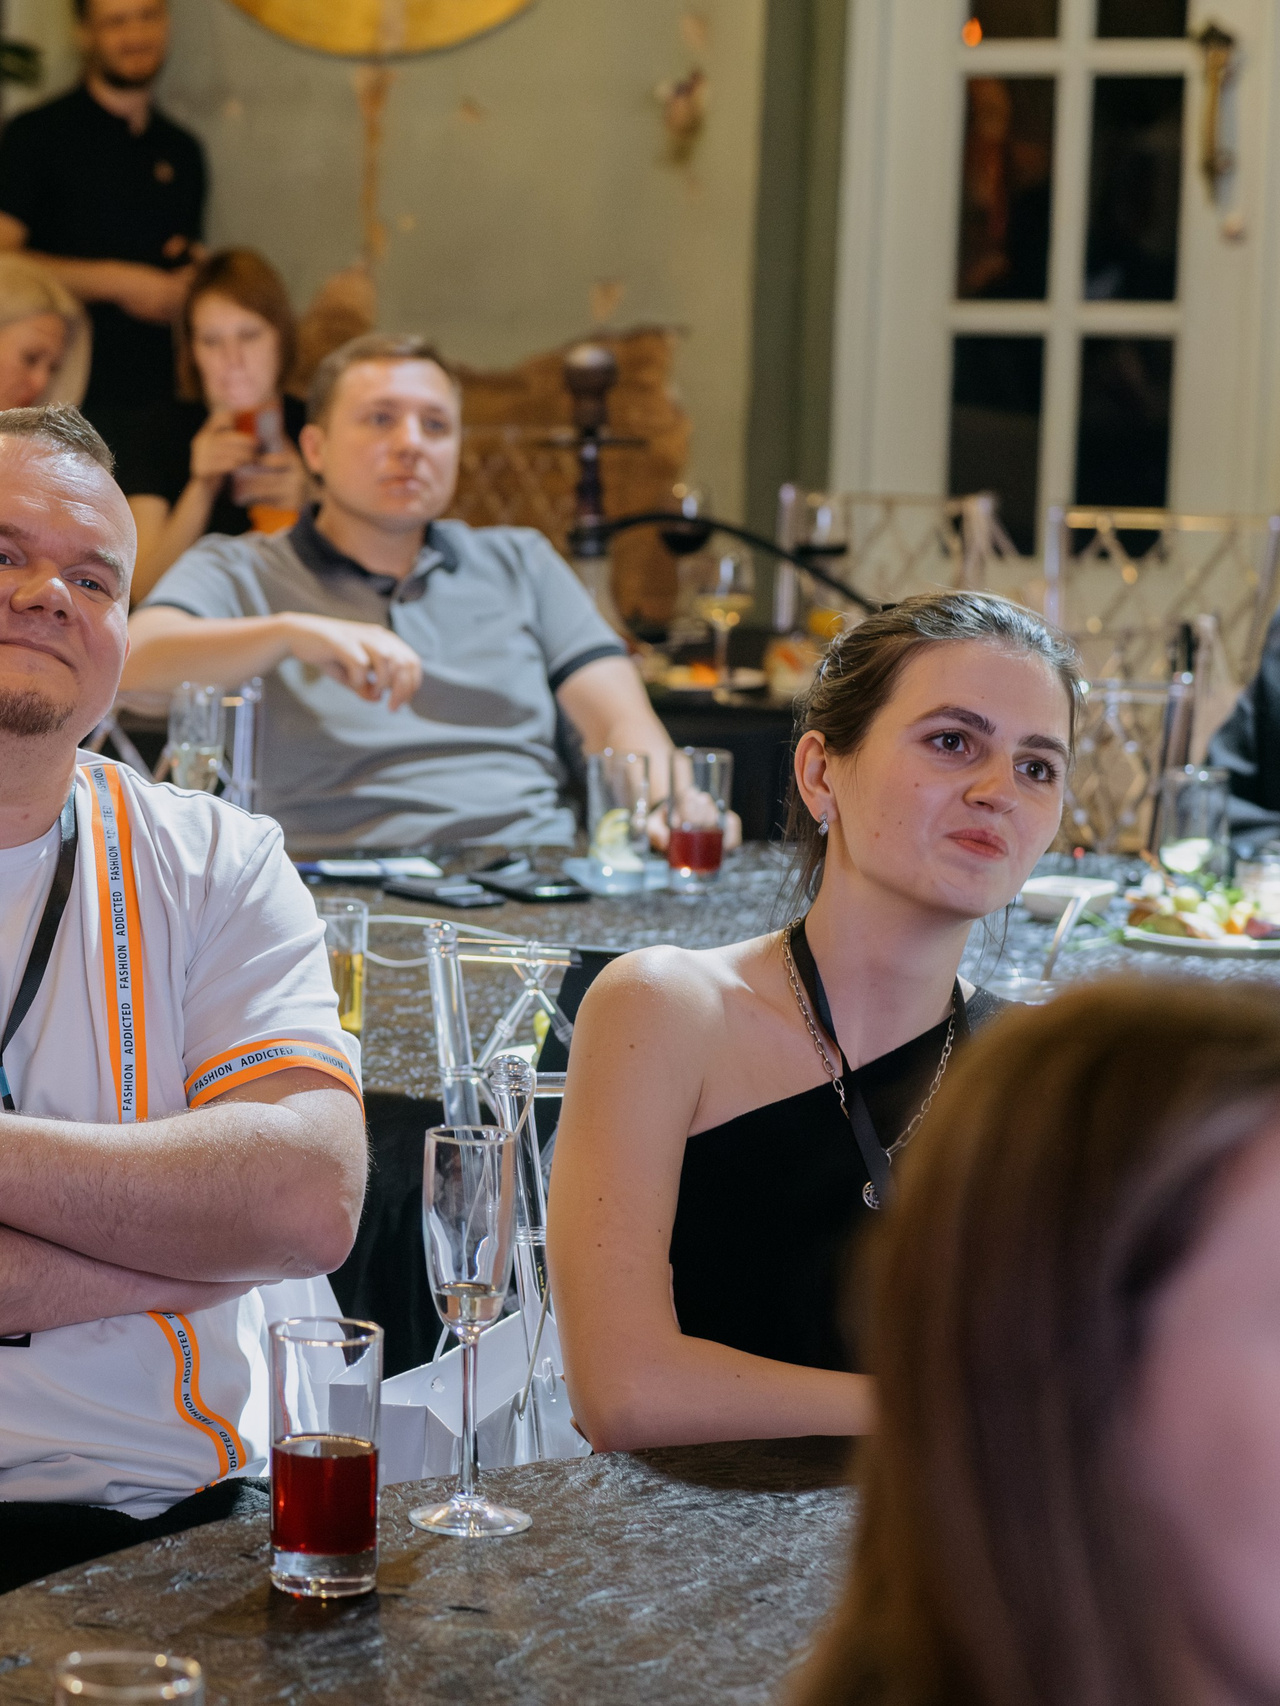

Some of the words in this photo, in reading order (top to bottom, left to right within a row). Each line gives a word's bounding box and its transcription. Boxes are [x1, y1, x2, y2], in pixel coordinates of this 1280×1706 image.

[102, 805, 116, 839] ADTED
[108, 845, 120, 881] FASHION
[112, 891, 126, 936] ADDICTED
[117, 945, 129, 989] FASHION
[121, 1002, 134, 1055] ADDICTED
[122, 1064, 134, 1111] FASHION
[194, 1063, 233, 1092] FASHION
[240, 1047, 293, 1068] ADDICTED
[177, 1330, 192, 1384] ADDICTED
[182, 1393, 214, 1425] FASHION
[219, 1431, 238, 1472] DICTED
